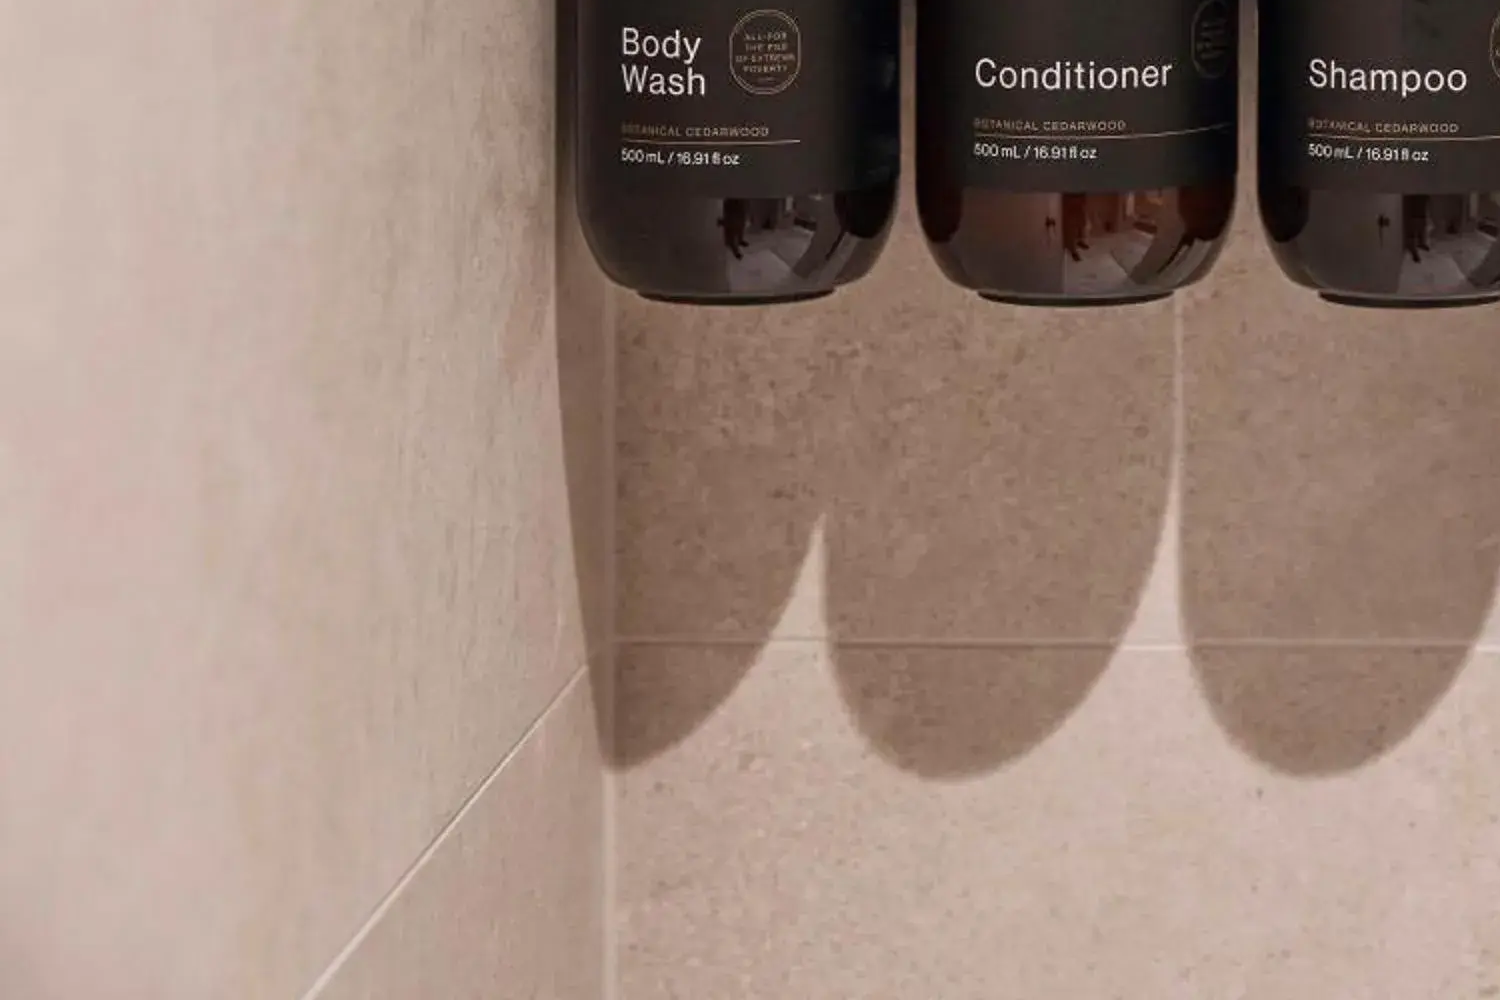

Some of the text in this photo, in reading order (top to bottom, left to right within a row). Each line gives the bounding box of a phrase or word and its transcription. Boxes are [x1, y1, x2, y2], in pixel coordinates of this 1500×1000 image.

[621, 27, 702, 65] Body
[621, 63, 706, 96] Wash
[975, 57, 1173, 91] Conditioner
[1309, 58, 1467, 98] Shampoo
[685, 126, 770, 137] CEDARWOOD
[1042, 120, 1127, 132] CEDARWOOD
[1374, 123, 1460, 133] CEDARWOOD
[621, 147, 645, 163] 500
[974, 143, 999, 157] 500
[1001, 145, 1021, 159] mL
[1023, 145, 1031, 159] /
[1309, 143, 1333, 158] 500
